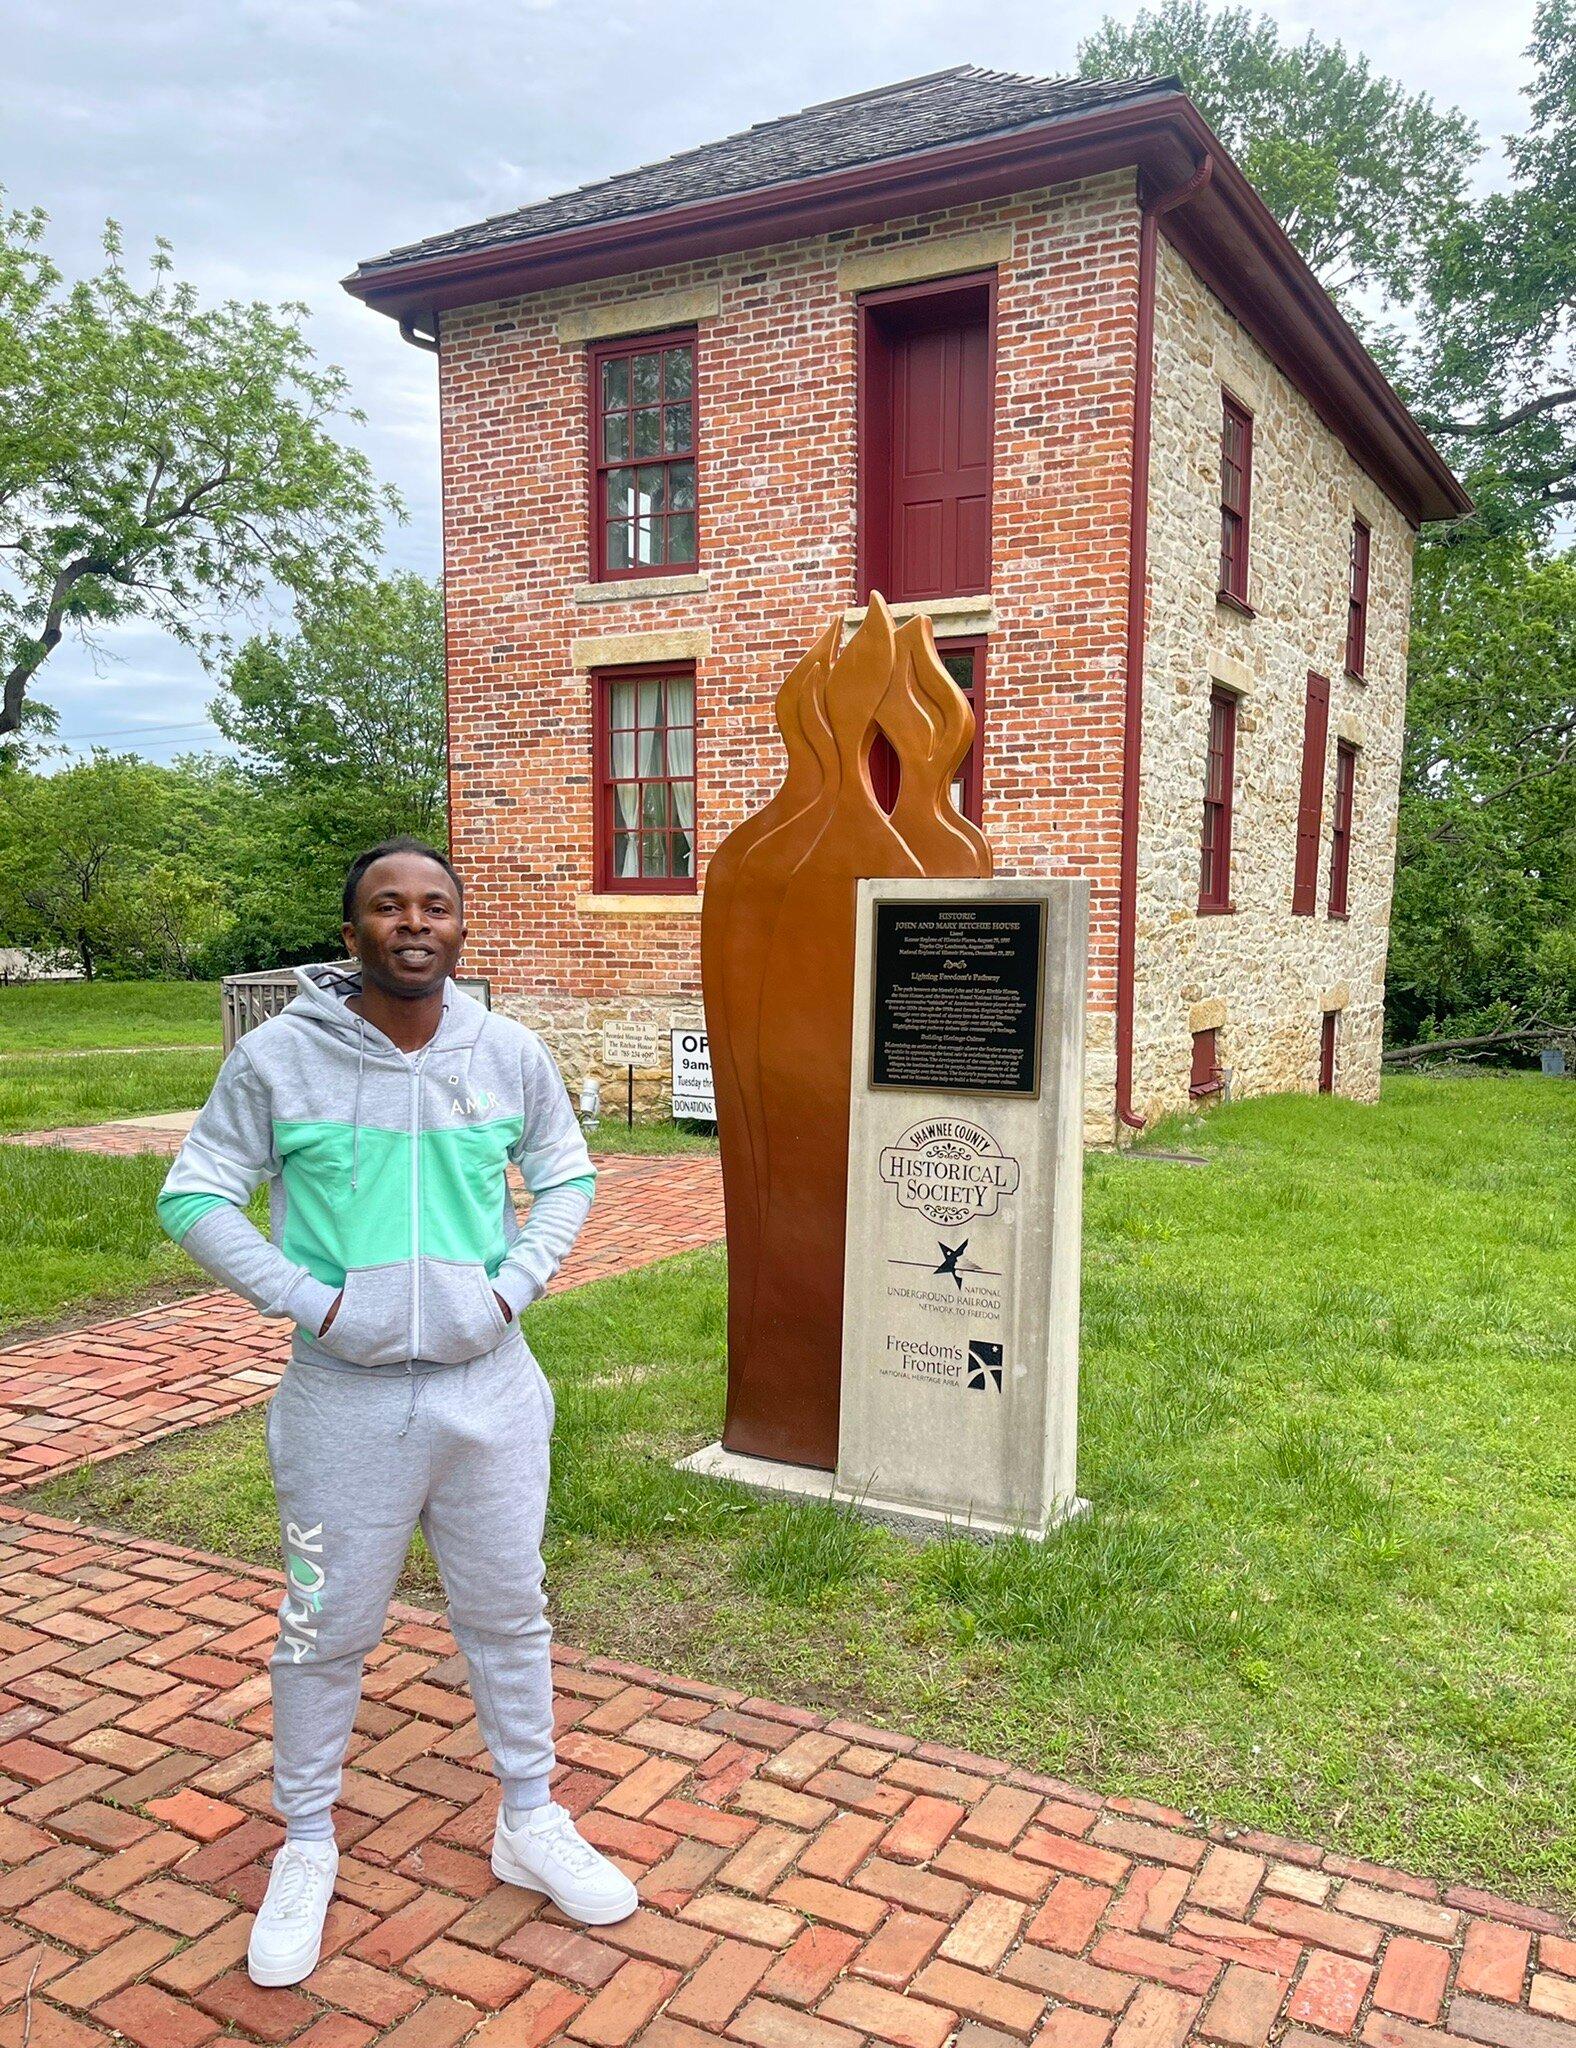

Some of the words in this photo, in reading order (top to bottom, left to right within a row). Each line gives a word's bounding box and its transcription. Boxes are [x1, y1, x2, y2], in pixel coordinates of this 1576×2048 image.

[938, 912, 976, 920] HISTORIC
[895, 922, 916, 931] JOHN
[911, 972, 939, 981] Lighting
[973, 974, 1000, 982] Pathway
[683, 1058, 712, 1070] 9am
[678, 1076, 701, 1090] Tuesday
[674, 1100, 713, 1114] DONATIONS
[910, 1123, 952, 1147] SHAWNEE
[954, 1124, 990, 1152] COUNTY
[890, 1156, 1007, 1187] HISTORICAL
[907, 1179, 988, 1207] SOCIETY
[887, 1287, 955, 1304] UNDERGROUND
[957, 1297, 1000, 1310] RAILROAD
[965, 1286, 1000, 1297] NATIONAL
[919, 1303, 954, 1315] NETWORK
[955, 1307, 966, 1316] TO
[967, 1309, 1000, 1320] FREEDOM
[887, 1335, 962, 1360] Freedom's
[903, 1355, 962, 1377] Frontier
[880, 1369, 910, 1380] NATIONAL
[912, 1374, 941, 1385] HERITAGE
[942, 1378, 960, 1387] AREA
